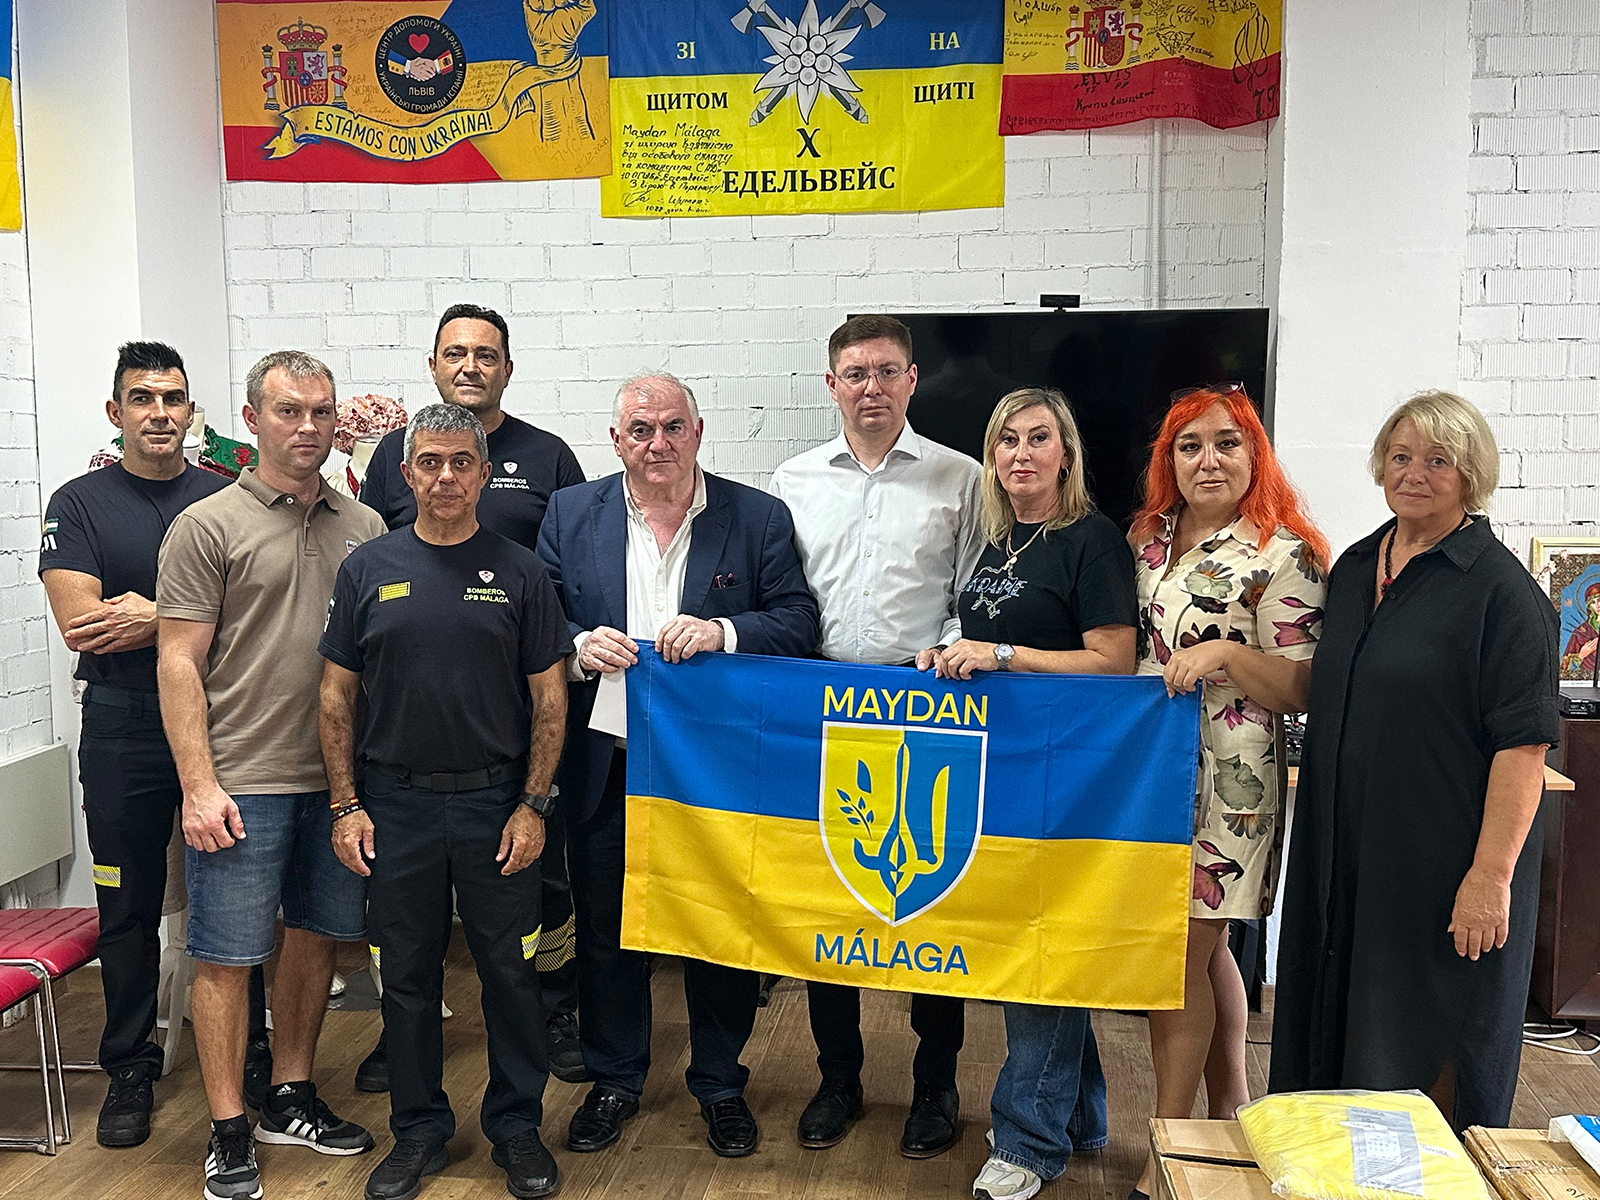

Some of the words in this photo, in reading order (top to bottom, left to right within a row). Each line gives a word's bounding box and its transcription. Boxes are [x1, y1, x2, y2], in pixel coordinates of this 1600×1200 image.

[378, 31, 394, 60] ЦЕНТР
[393, 18, 441, 36] ДОПОМОГИ
[440, 27, 463, 59] УКРАЇНІ
[676, 41, 696, 60] ЗІ
[929, 31, 960, 51] НА
[378, 70, 411, 110] УКРАЇНСЬКІ
[411, 97, 449, 113] ГРОМАДИ
[446, 70, 464, 100] ІСПАНІЇ
[408, 87, 436, 96] ЛЬВІВ
[646, 91, 729, 114] ЩИТОМ
[913, 81, 975, 106] ЩИТІ
[315, 111, 384, 150] ESTAMOS
[388, 134, 417, 156] CON
[419, 111, 493, 154] UKRAINA!
[622, 124, 667, 140] Maydan
[674, 122, 721, 140] Málaga
[723, 161, 896, 199] ЕДЕЛЬВЕЙС
[492, 477, 527, 485] BOMBEROS
[466, 587, 506, 596] BOMBEROS
[823, 685, 989, 727] MAYDAN
[814, 928, 969, 976] MÁLAGA
